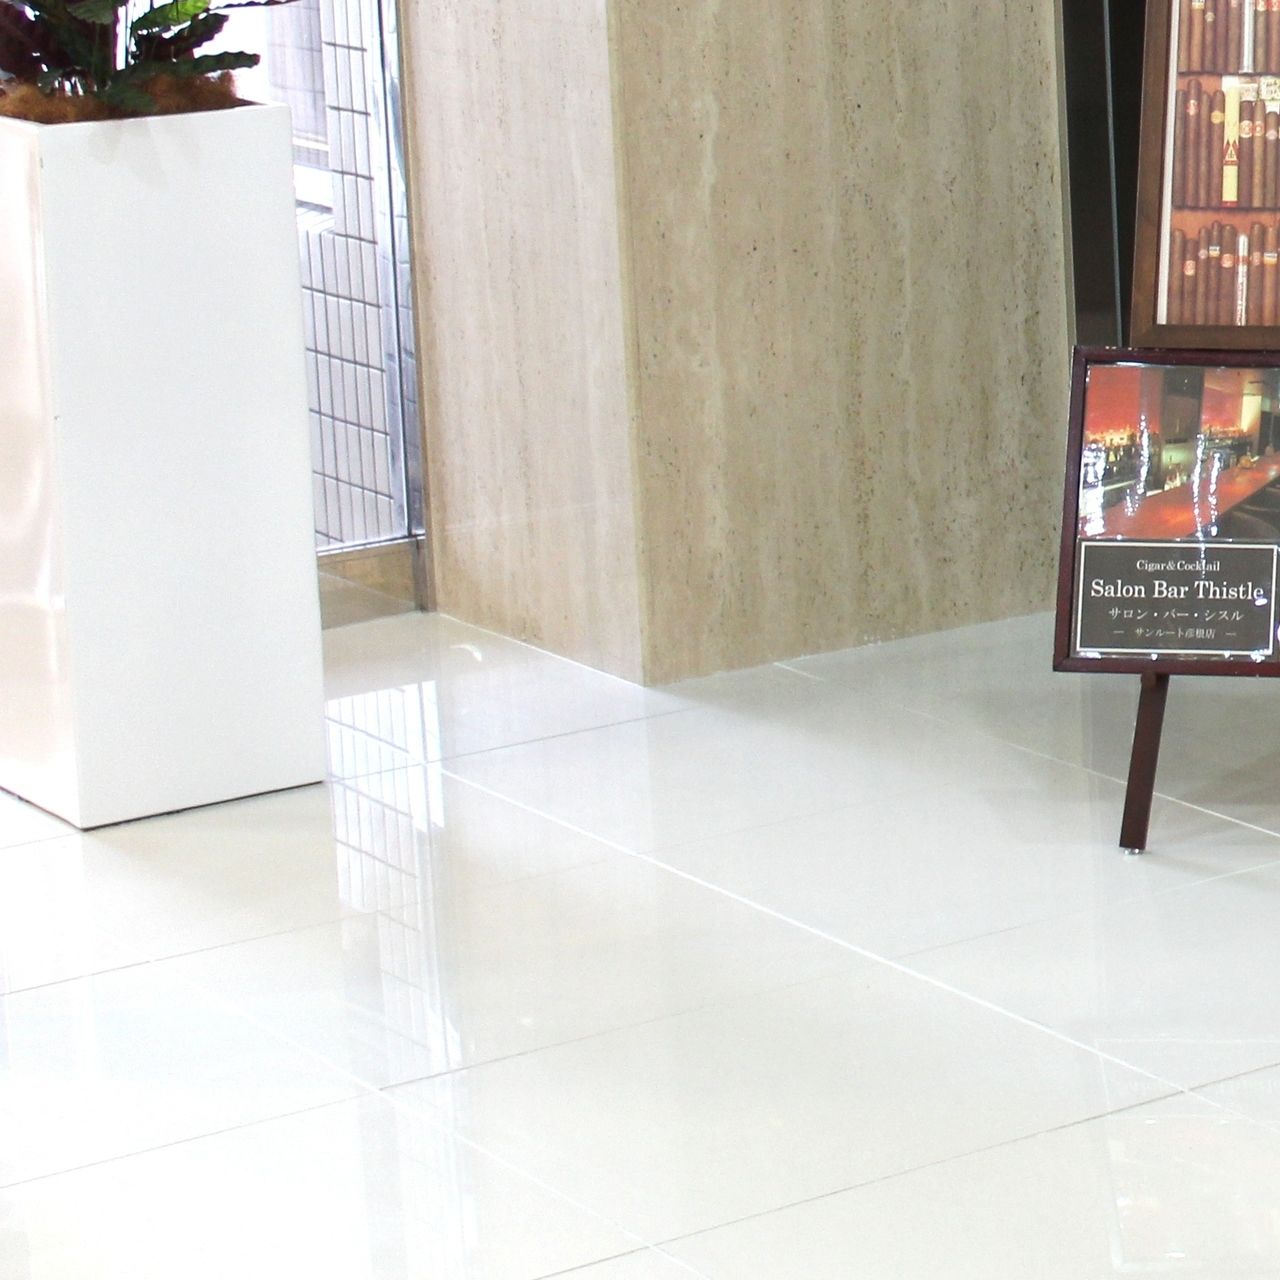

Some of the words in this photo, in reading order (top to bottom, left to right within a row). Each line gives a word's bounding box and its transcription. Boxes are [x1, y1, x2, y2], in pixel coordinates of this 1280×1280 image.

[1090, 578, 1146, 598] Salon
[1152, 580, 1190, 599] Bar
[1194, 580, 1264, 600] Thistle
[1108, 607, 1245, 622] サロン・バー・シスル
